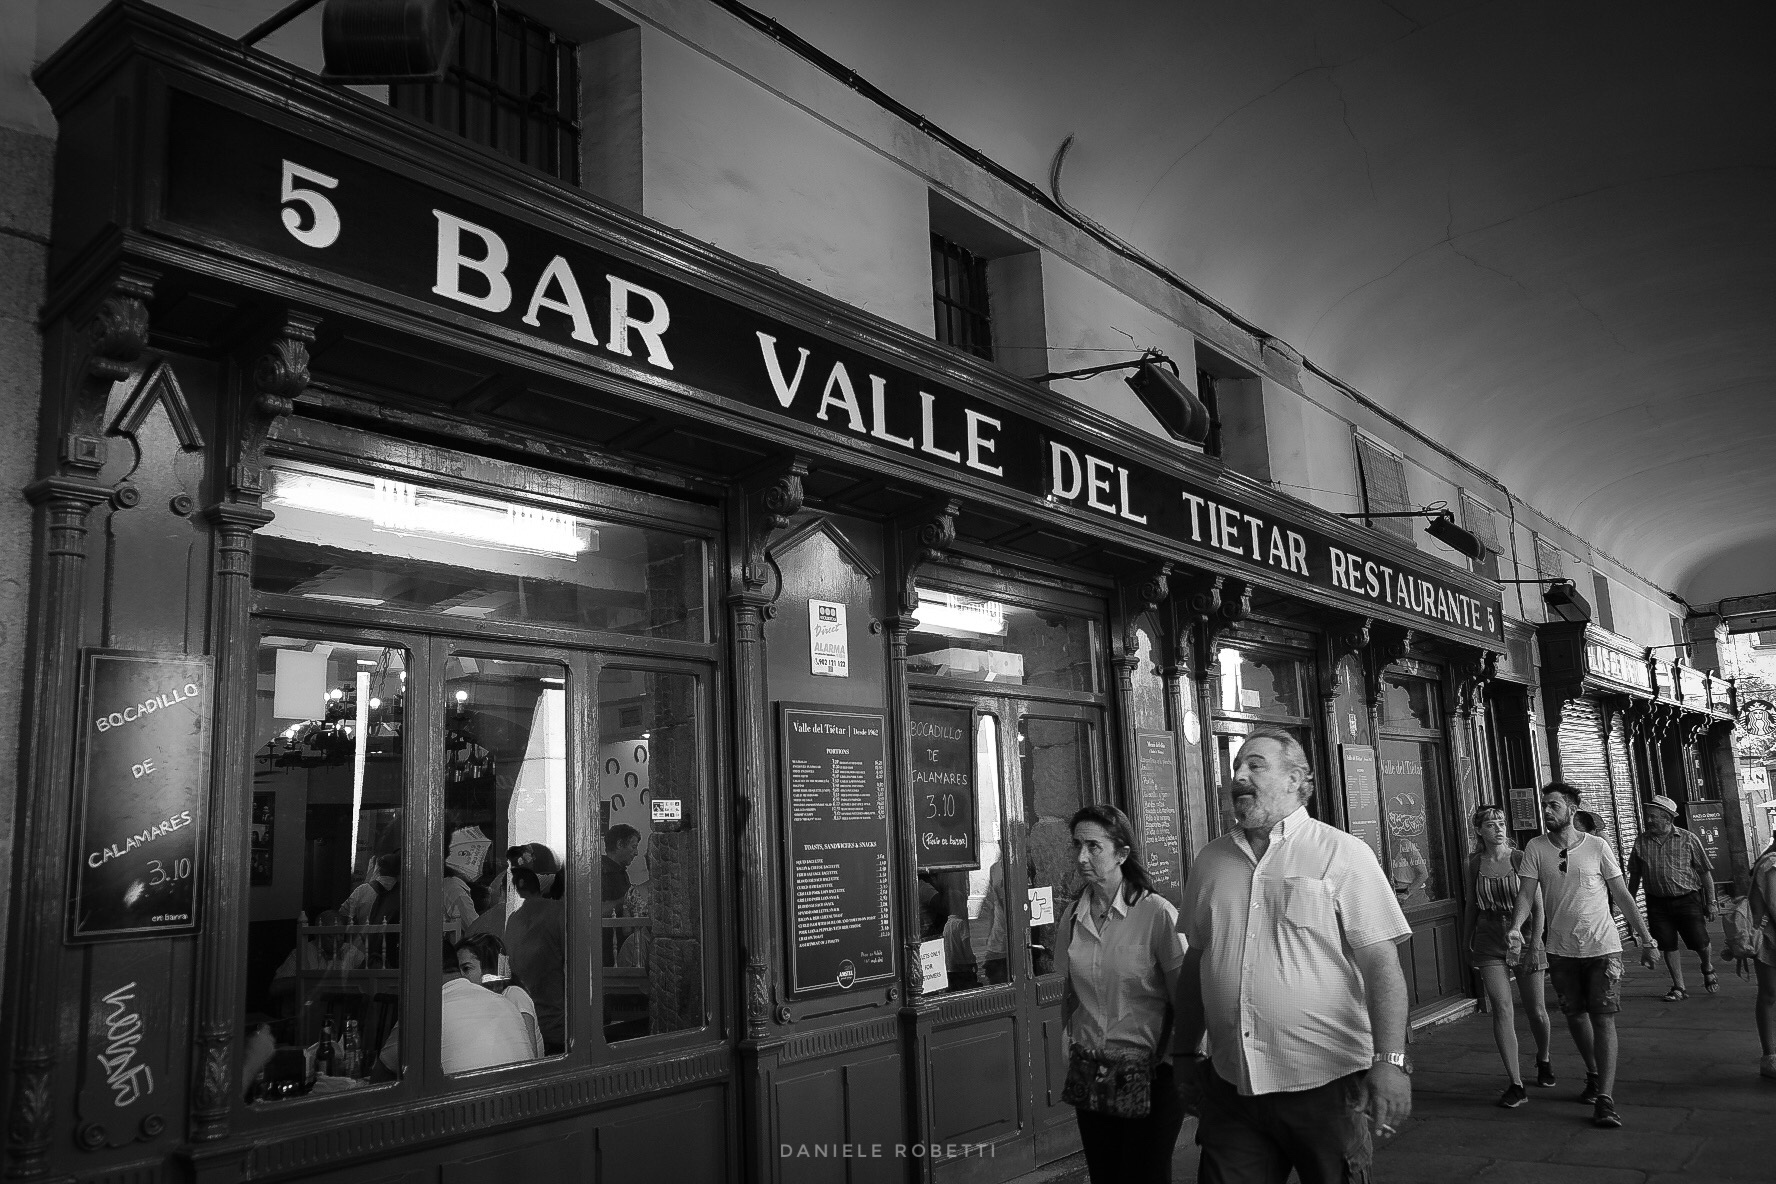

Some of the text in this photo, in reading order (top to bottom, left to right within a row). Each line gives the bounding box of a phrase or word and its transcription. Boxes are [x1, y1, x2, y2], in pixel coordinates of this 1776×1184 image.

[280, 159, 1497, 634] 5 BAR VALLE DEL TIETAR RESTAURANTE 5
[814, 642, 846, 654] ALARMA
[95, 683, 199, 733] BOCADILLO
[793, 721, 811, 733] Valle
[812, 723, 823, 734] del
[910, 720, 963, 741] BOCADILLO
[131, 757, 156, 779] DE
[911, 769, 968, 785] CALAMARES
[926, 793, 955, 819] 3.10
[88, 810, 193, 868] CALAMARES
[146, 857, 191, 886] 3.10
